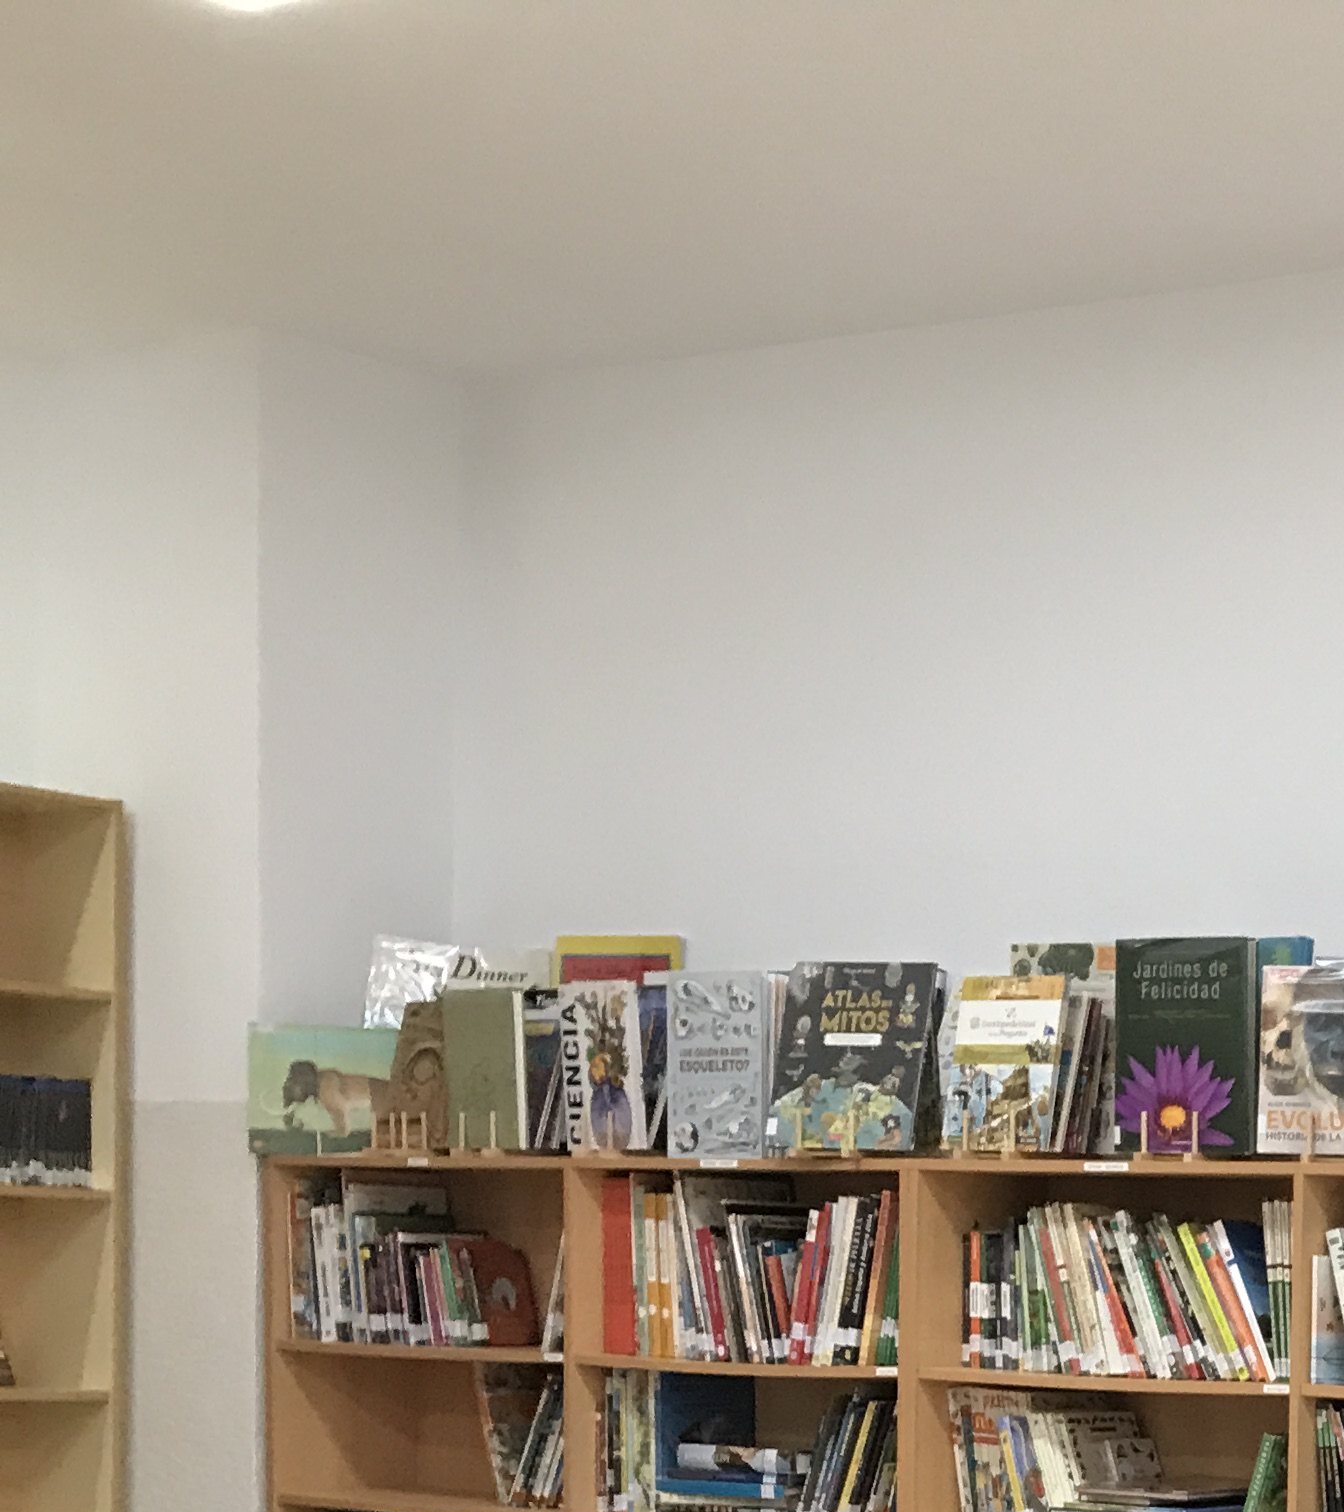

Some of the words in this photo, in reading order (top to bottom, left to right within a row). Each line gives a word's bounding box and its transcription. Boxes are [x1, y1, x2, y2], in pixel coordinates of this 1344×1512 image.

[1133, 960, 1202, 980] Jardines
[1208, 960, 1229, 979] de
[821, 989, 882, 1009] ATLAS
[1140, 980, 1221, 1000] Felicidad
[819, 1009, 891, 1033] MITOS
[563, 1001, 581, 1146] CIENCIA
[679, 1059, 751, 1075] ESQUELETO?
